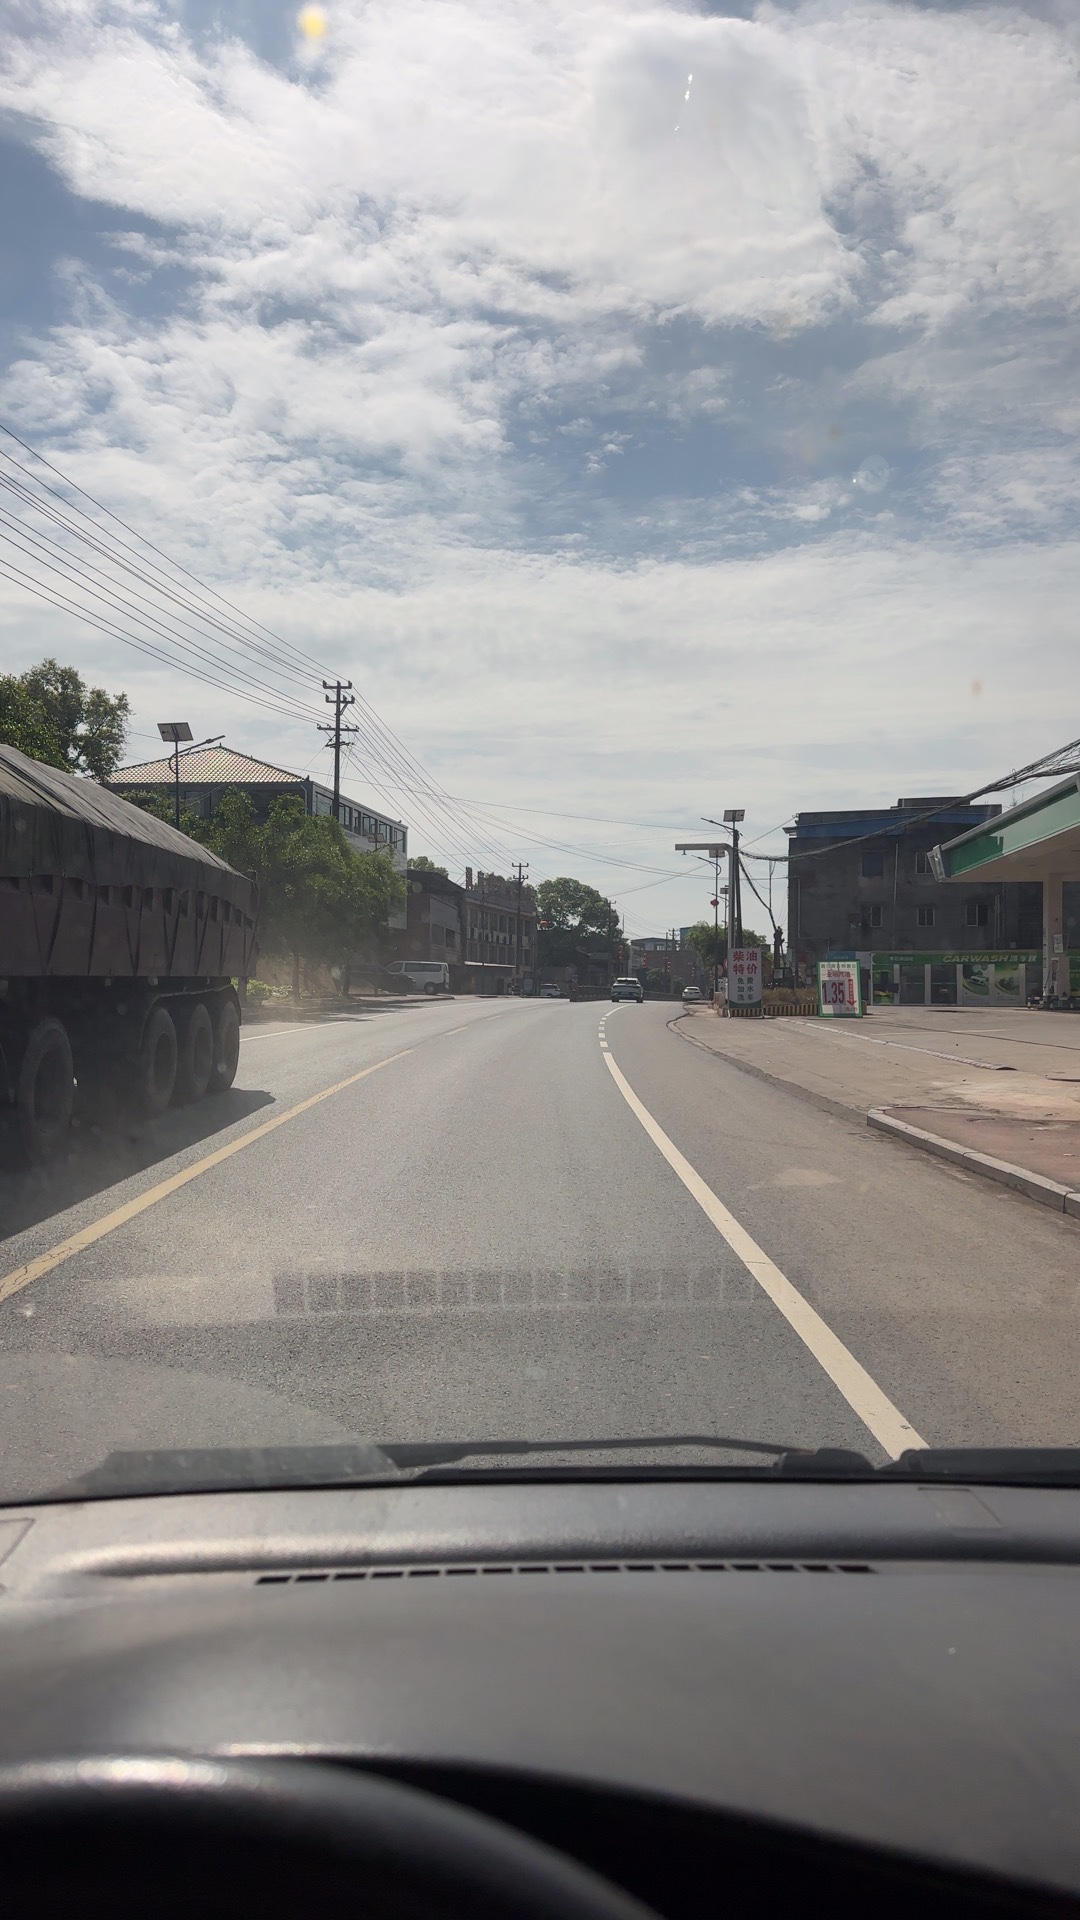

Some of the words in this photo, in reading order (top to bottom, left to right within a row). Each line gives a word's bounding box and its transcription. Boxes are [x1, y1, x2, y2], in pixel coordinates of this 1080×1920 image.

[732, 950, 758, 962] 柴油
[942, 954, 1009, 963] CARWASH
[732, 963, 758, 975] 特价
[737, 985, 754, 993] 加水
[822, 981, 845, 1004] 1.35
